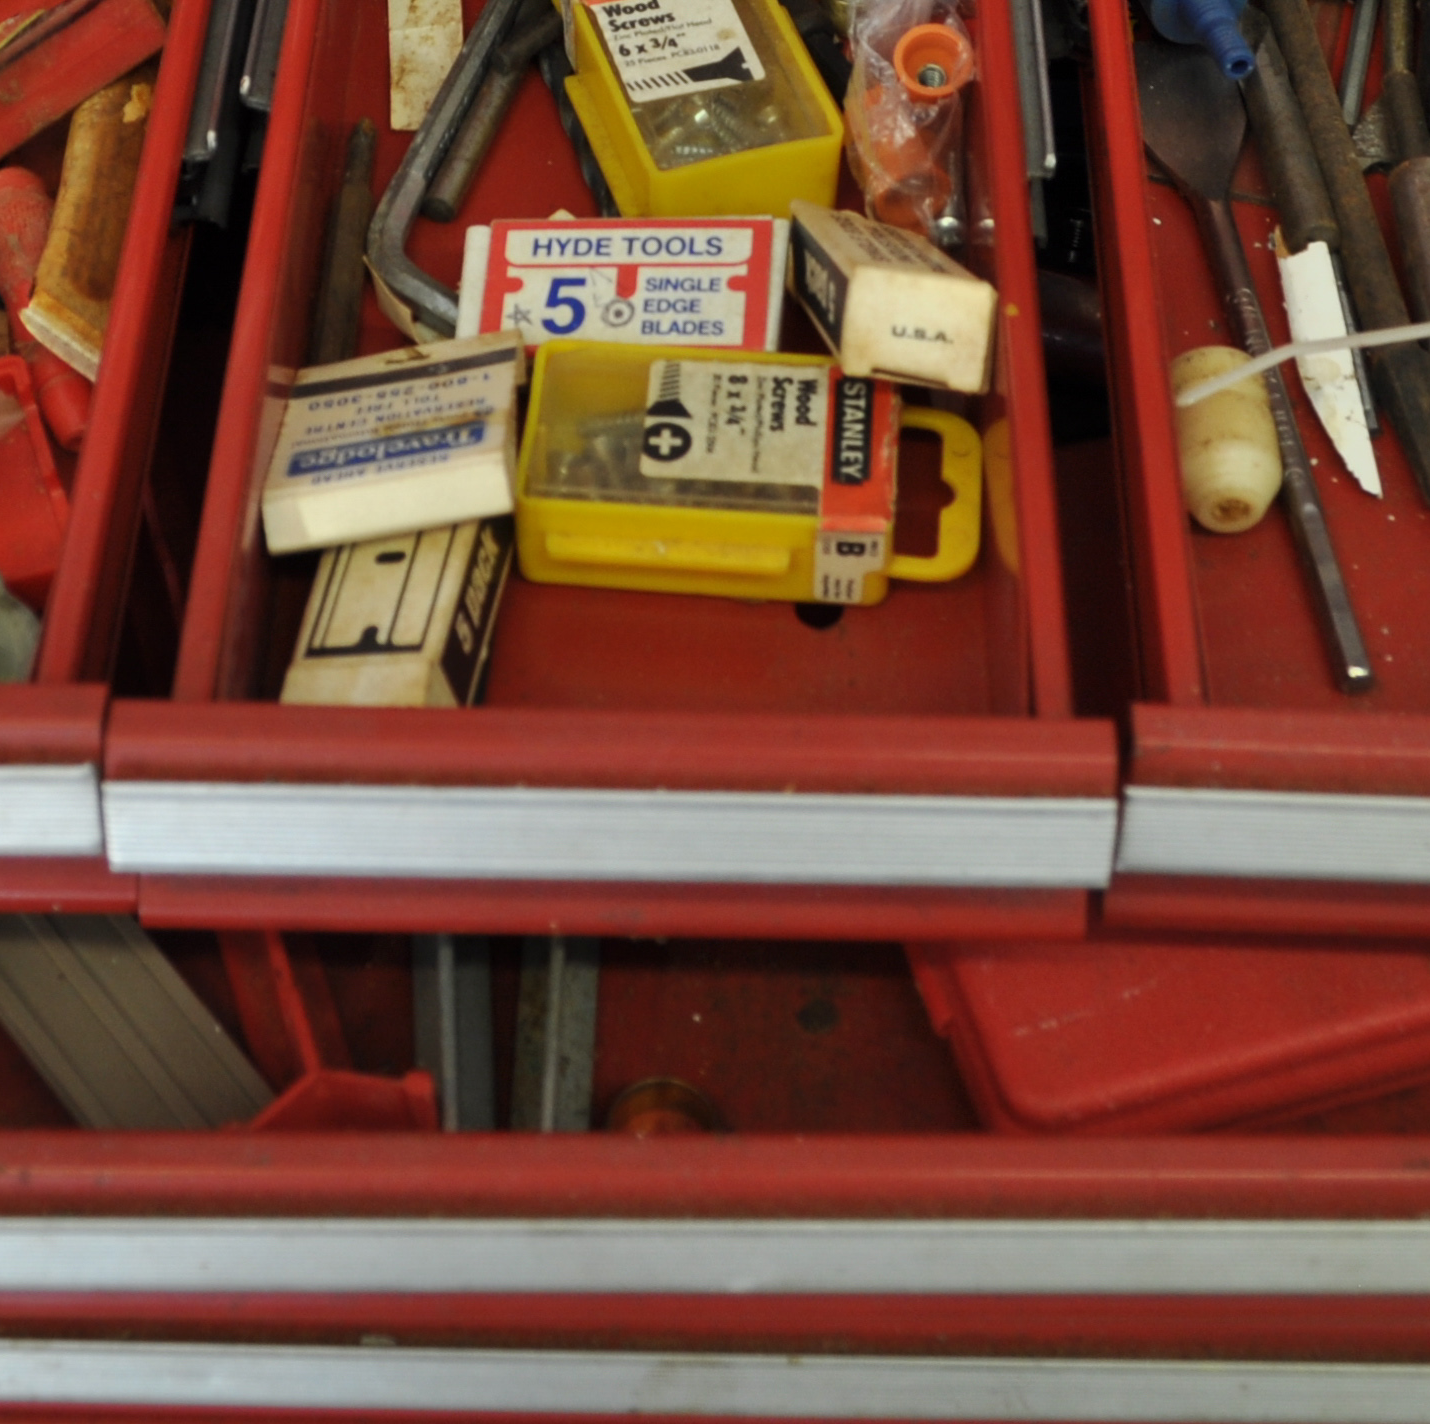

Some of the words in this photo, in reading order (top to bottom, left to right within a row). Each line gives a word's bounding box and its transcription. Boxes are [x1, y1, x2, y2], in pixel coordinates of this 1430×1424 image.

[608, 11, 676, 33] Screws
[618, 43, 631, 57] 6
[635, 43, 648, 55] x
[532, 237, 613, 258] HYDE
[621, 236, 724, 257] TOOLS
[644, 277, 721, 293] SINGLE
[541, 278, 588, 336] 5
[642, 298, 702, 314] EDGE
[640, 320, 725, 336] BLADES
[891, 325, 956, 345] U.S.A.
[727, 374, 749, 385] 8
[769, 375, 794, 433] Screws
[794, 377, 819, 428] Wood
[839, 380, 867, 481] STANLEY
[297, 428, 474, 469] Travelodge
[835, 540, 867, 559] B
